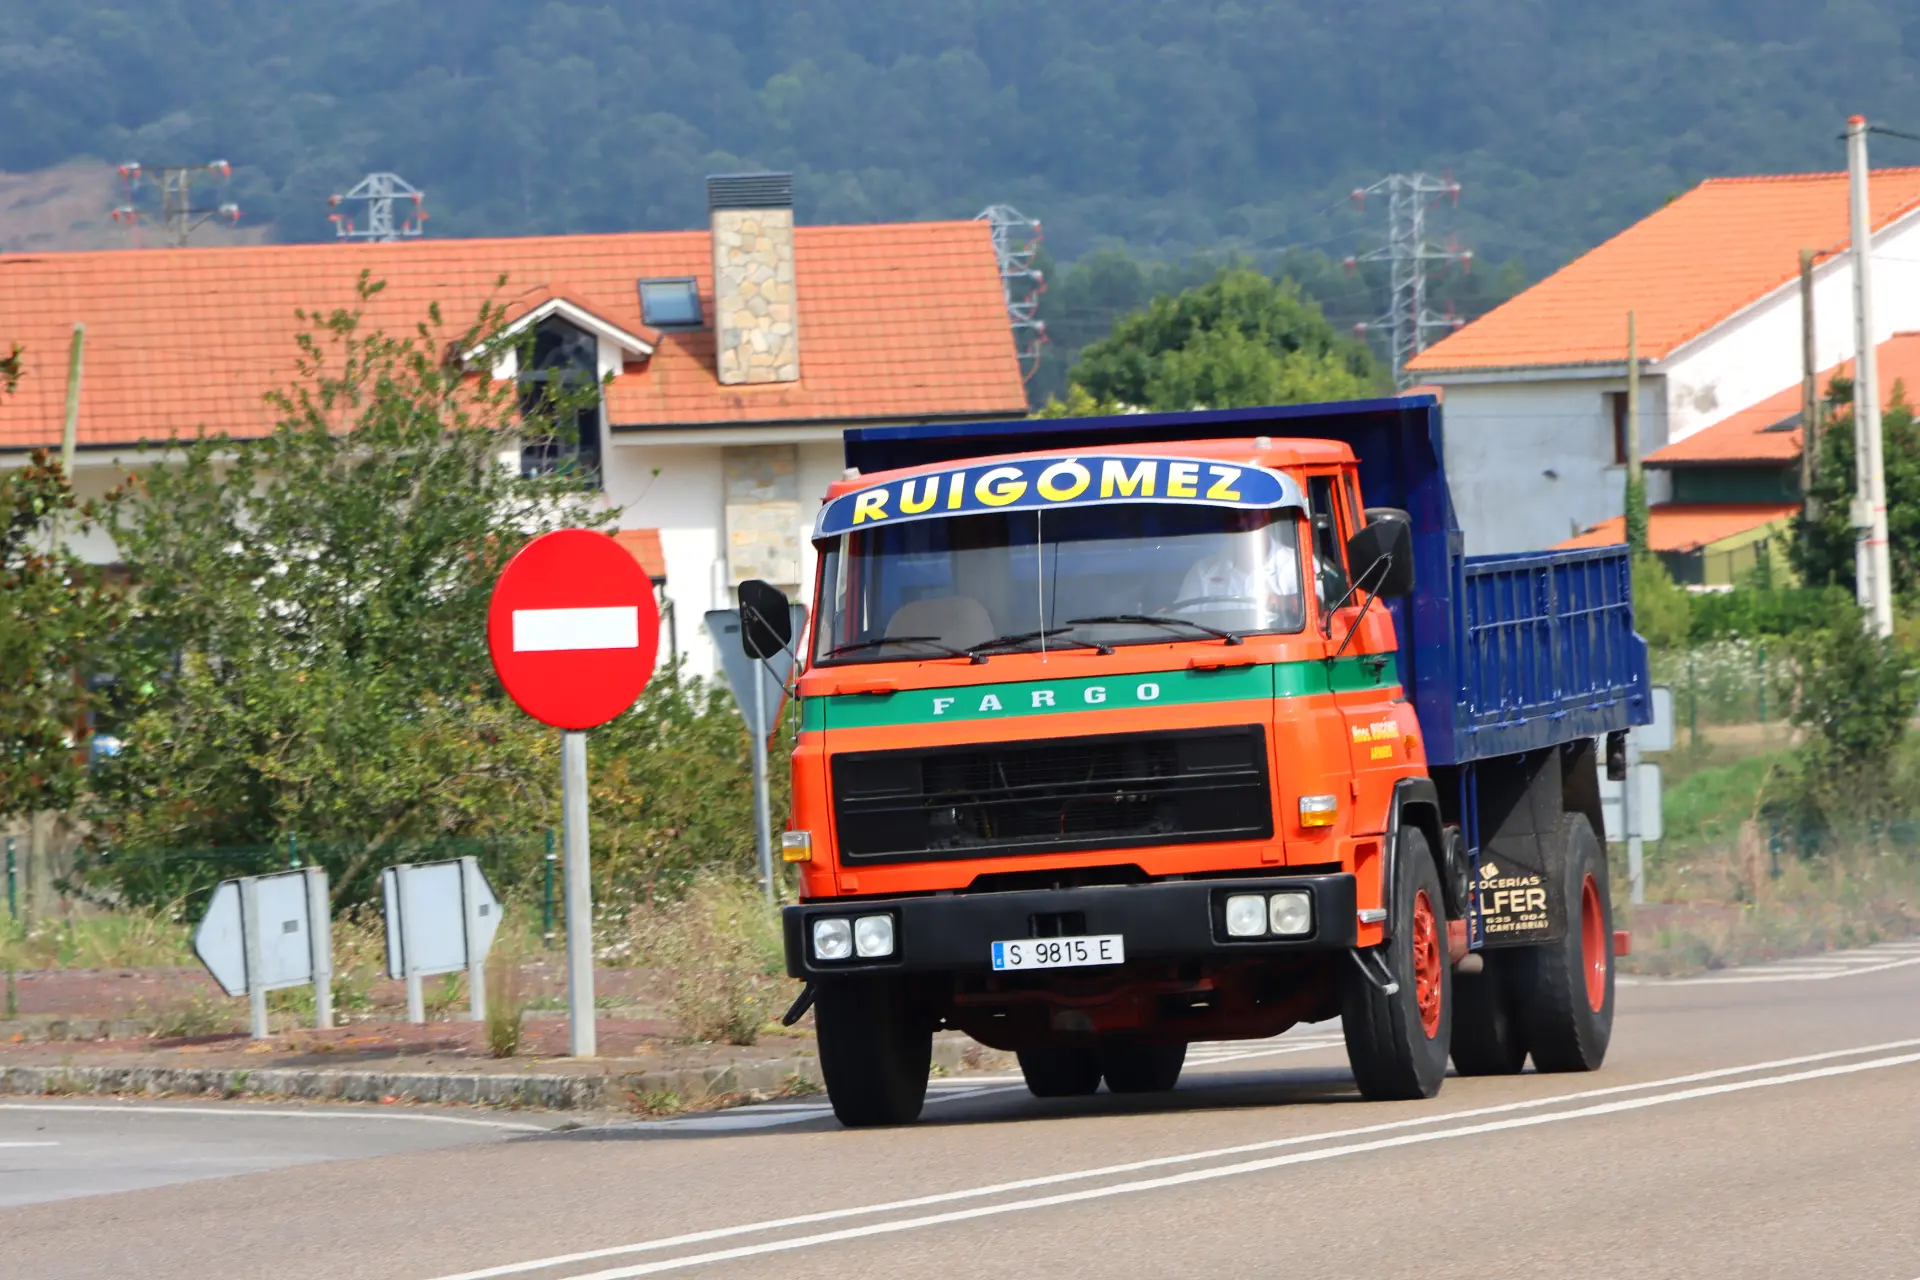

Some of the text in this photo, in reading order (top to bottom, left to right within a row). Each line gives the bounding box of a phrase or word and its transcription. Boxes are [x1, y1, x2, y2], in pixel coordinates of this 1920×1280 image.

[852, 458, 1241, 524] RUIGÓMEZ
[932, 682, 1160, 715] FARGO
[1470, 888, 1547, 917] LFER
[1010, 939, 1112, 965] S 9815 E
